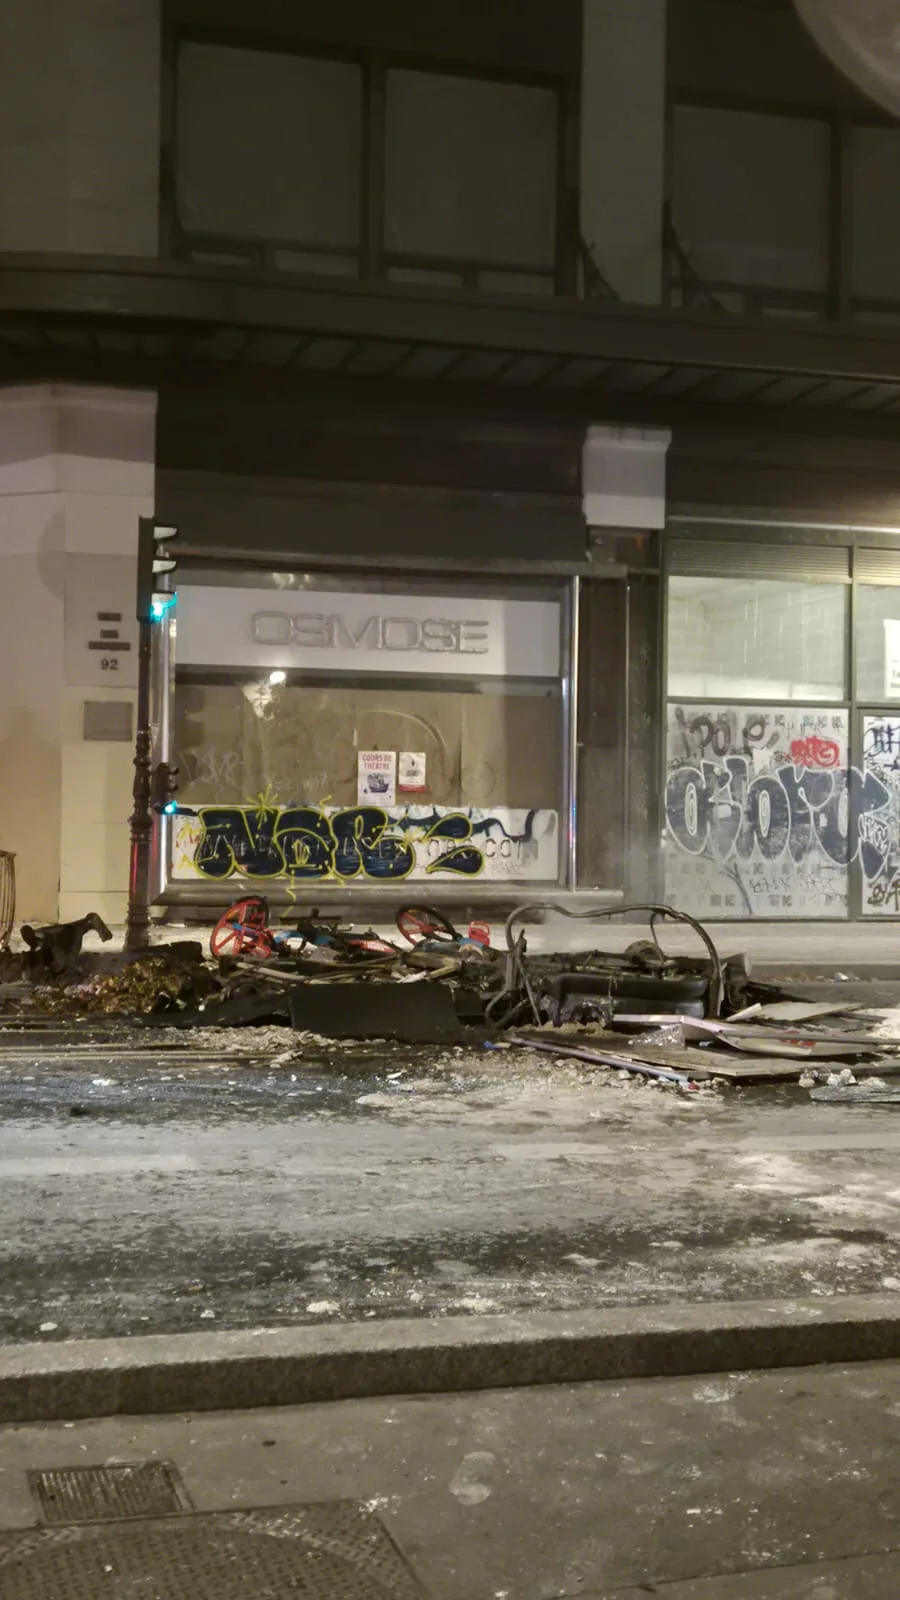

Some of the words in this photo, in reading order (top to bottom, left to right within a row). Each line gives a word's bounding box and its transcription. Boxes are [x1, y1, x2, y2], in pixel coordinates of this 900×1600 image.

[251, 610, 489, 654] OSMOSE
[101, 658, 119, 671] 92
[362, 753, 382, 762] COURS
